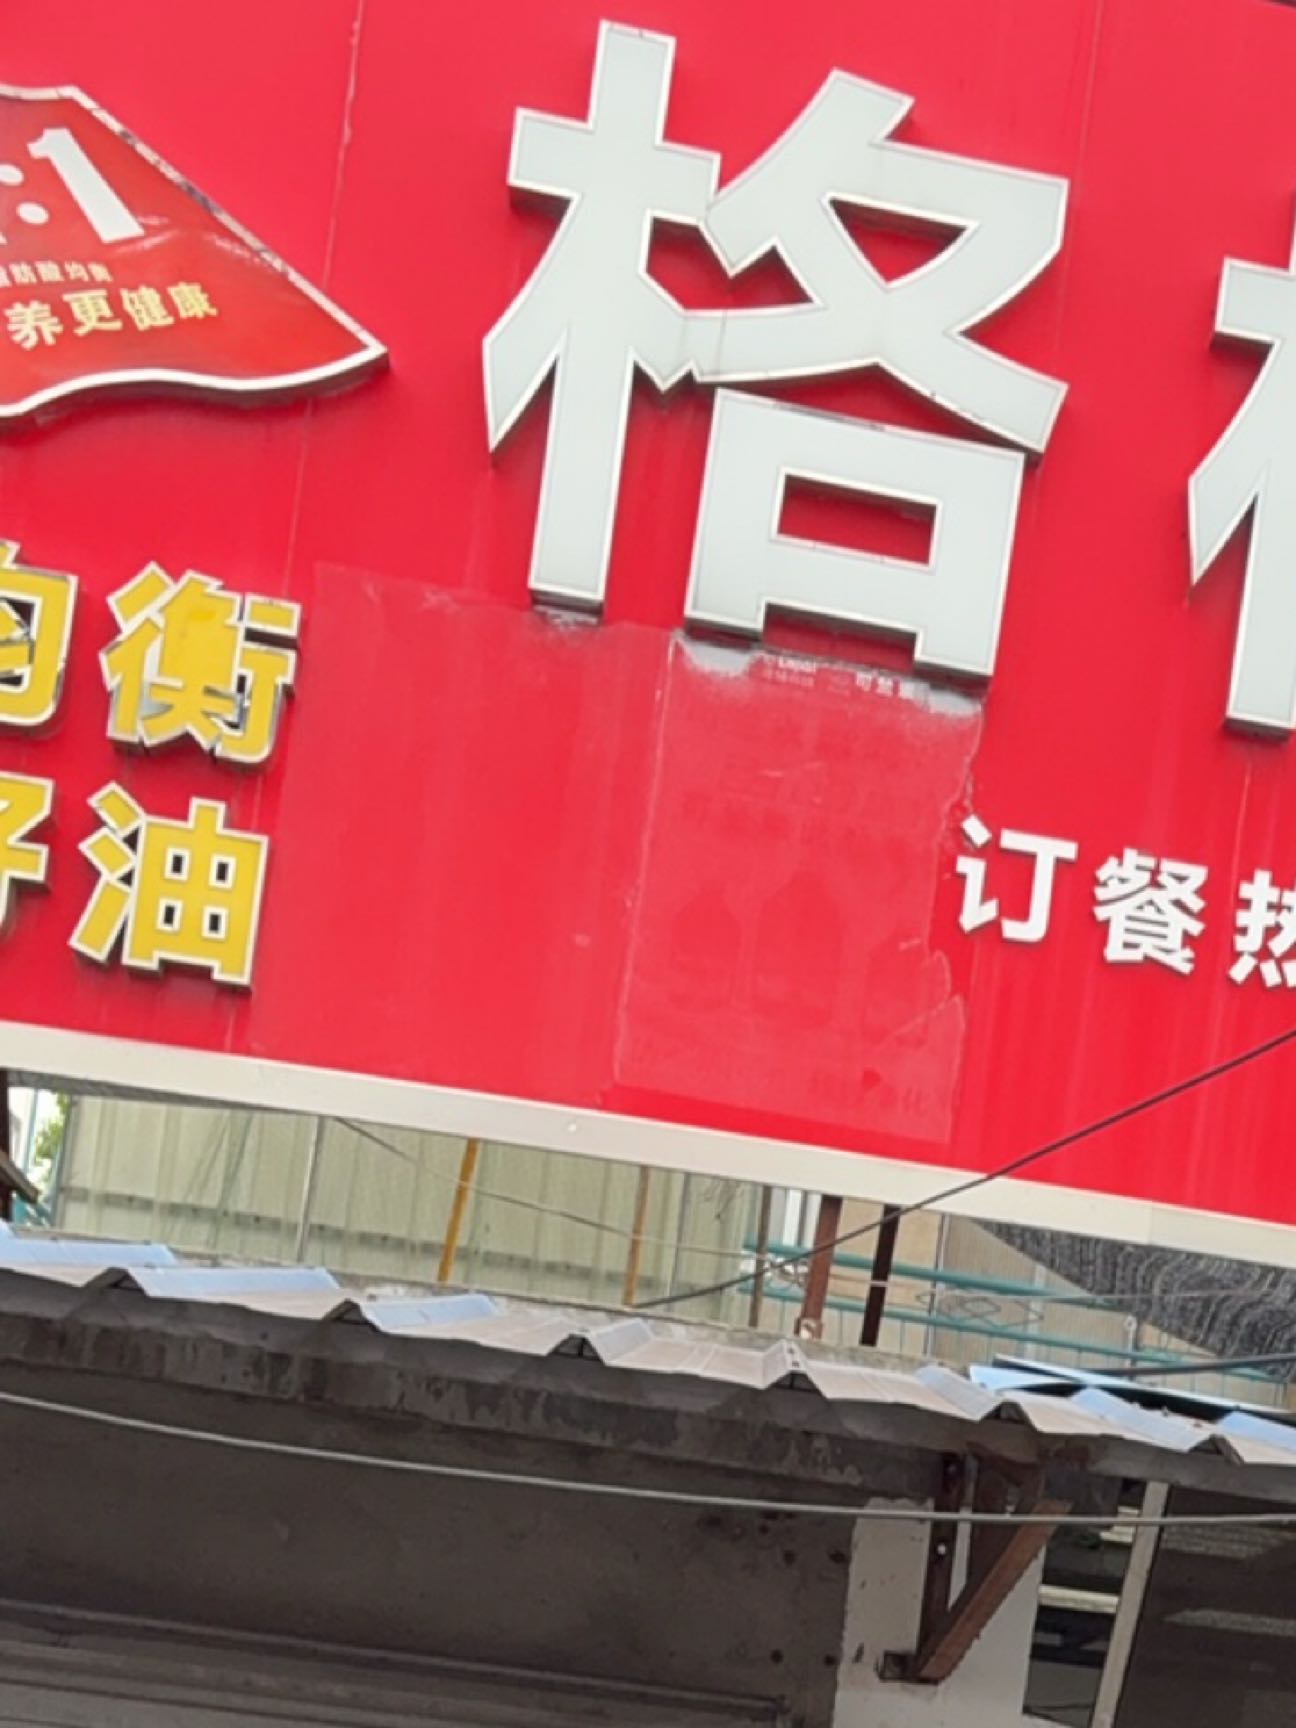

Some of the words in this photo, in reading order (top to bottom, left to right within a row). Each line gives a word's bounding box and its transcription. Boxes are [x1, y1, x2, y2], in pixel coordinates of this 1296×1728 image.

[0, 128, 145, 244] :1
[4, 281, 218, 350] 养更健康
[0, 771, 269, 986] 油
